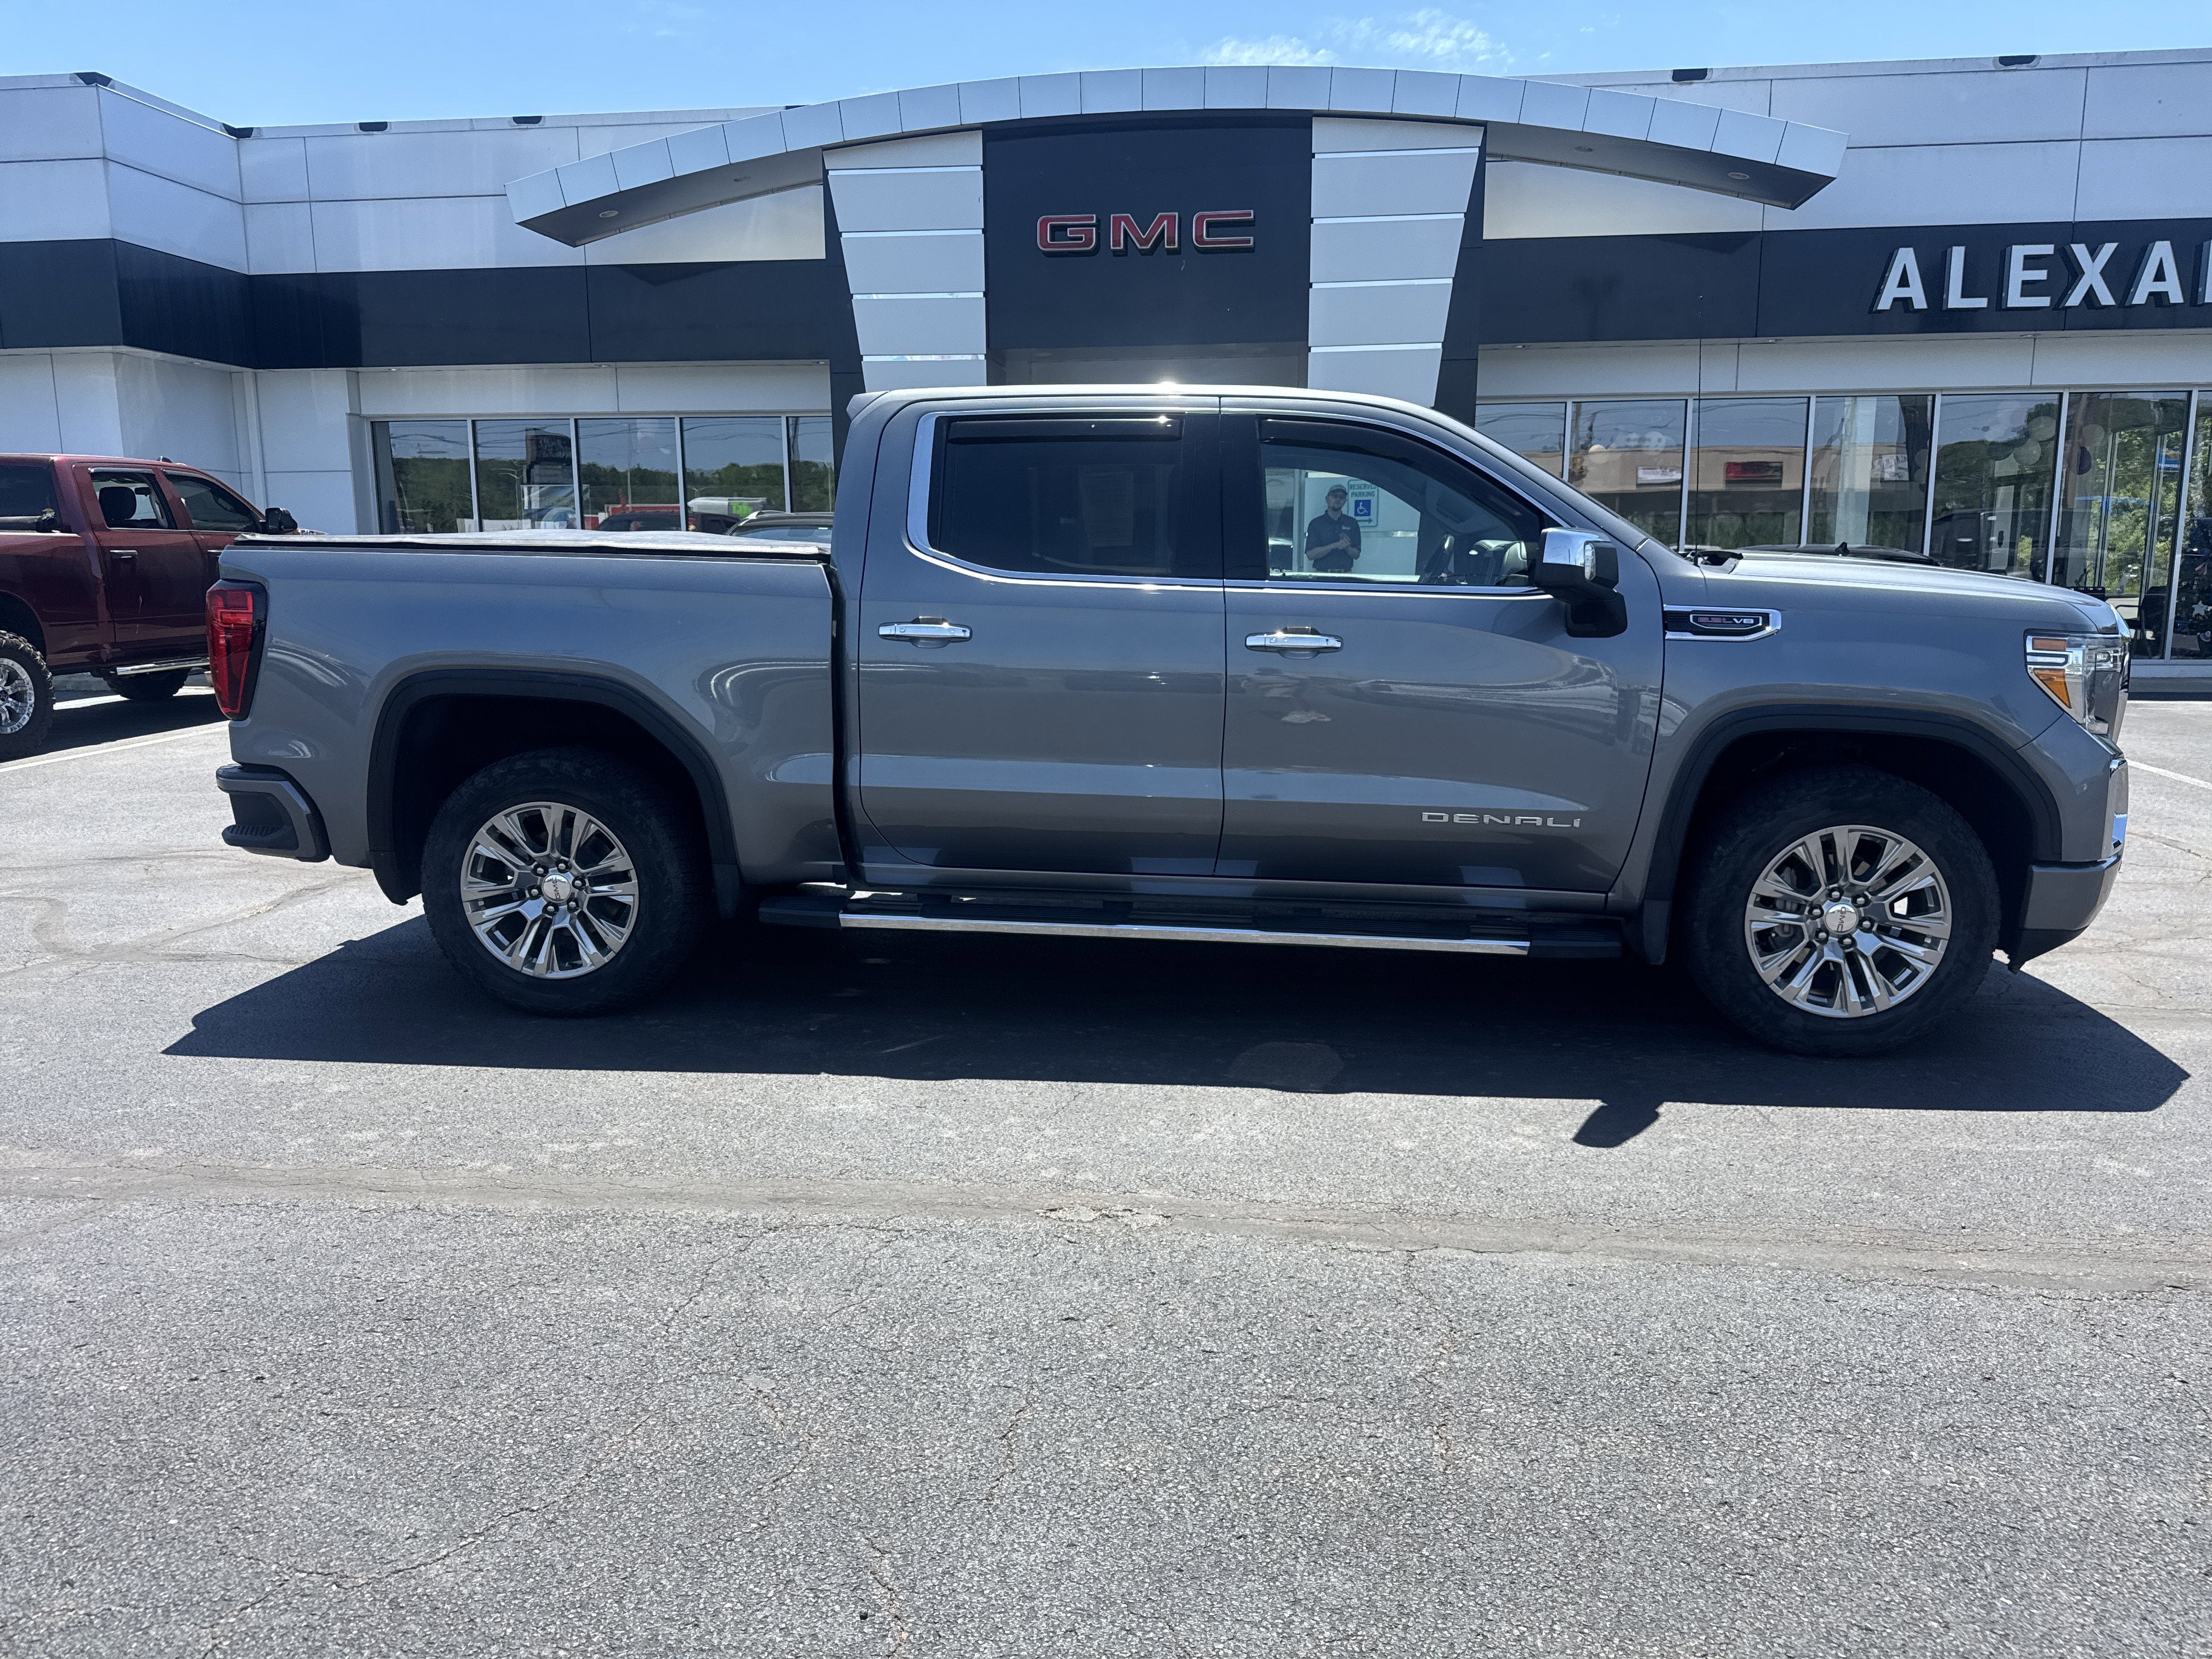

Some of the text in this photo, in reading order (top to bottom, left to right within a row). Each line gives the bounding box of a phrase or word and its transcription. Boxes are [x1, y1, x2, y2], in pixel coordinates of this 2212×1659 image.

[1037, 209, 1254, 251] GMC
[1873, 239, 2212, 311] ALEXA
[1422, 812, 1580, 828] DENALI
[551, 877, 561, 900] GMC
[1837, 906, 1847, 932] GMC
